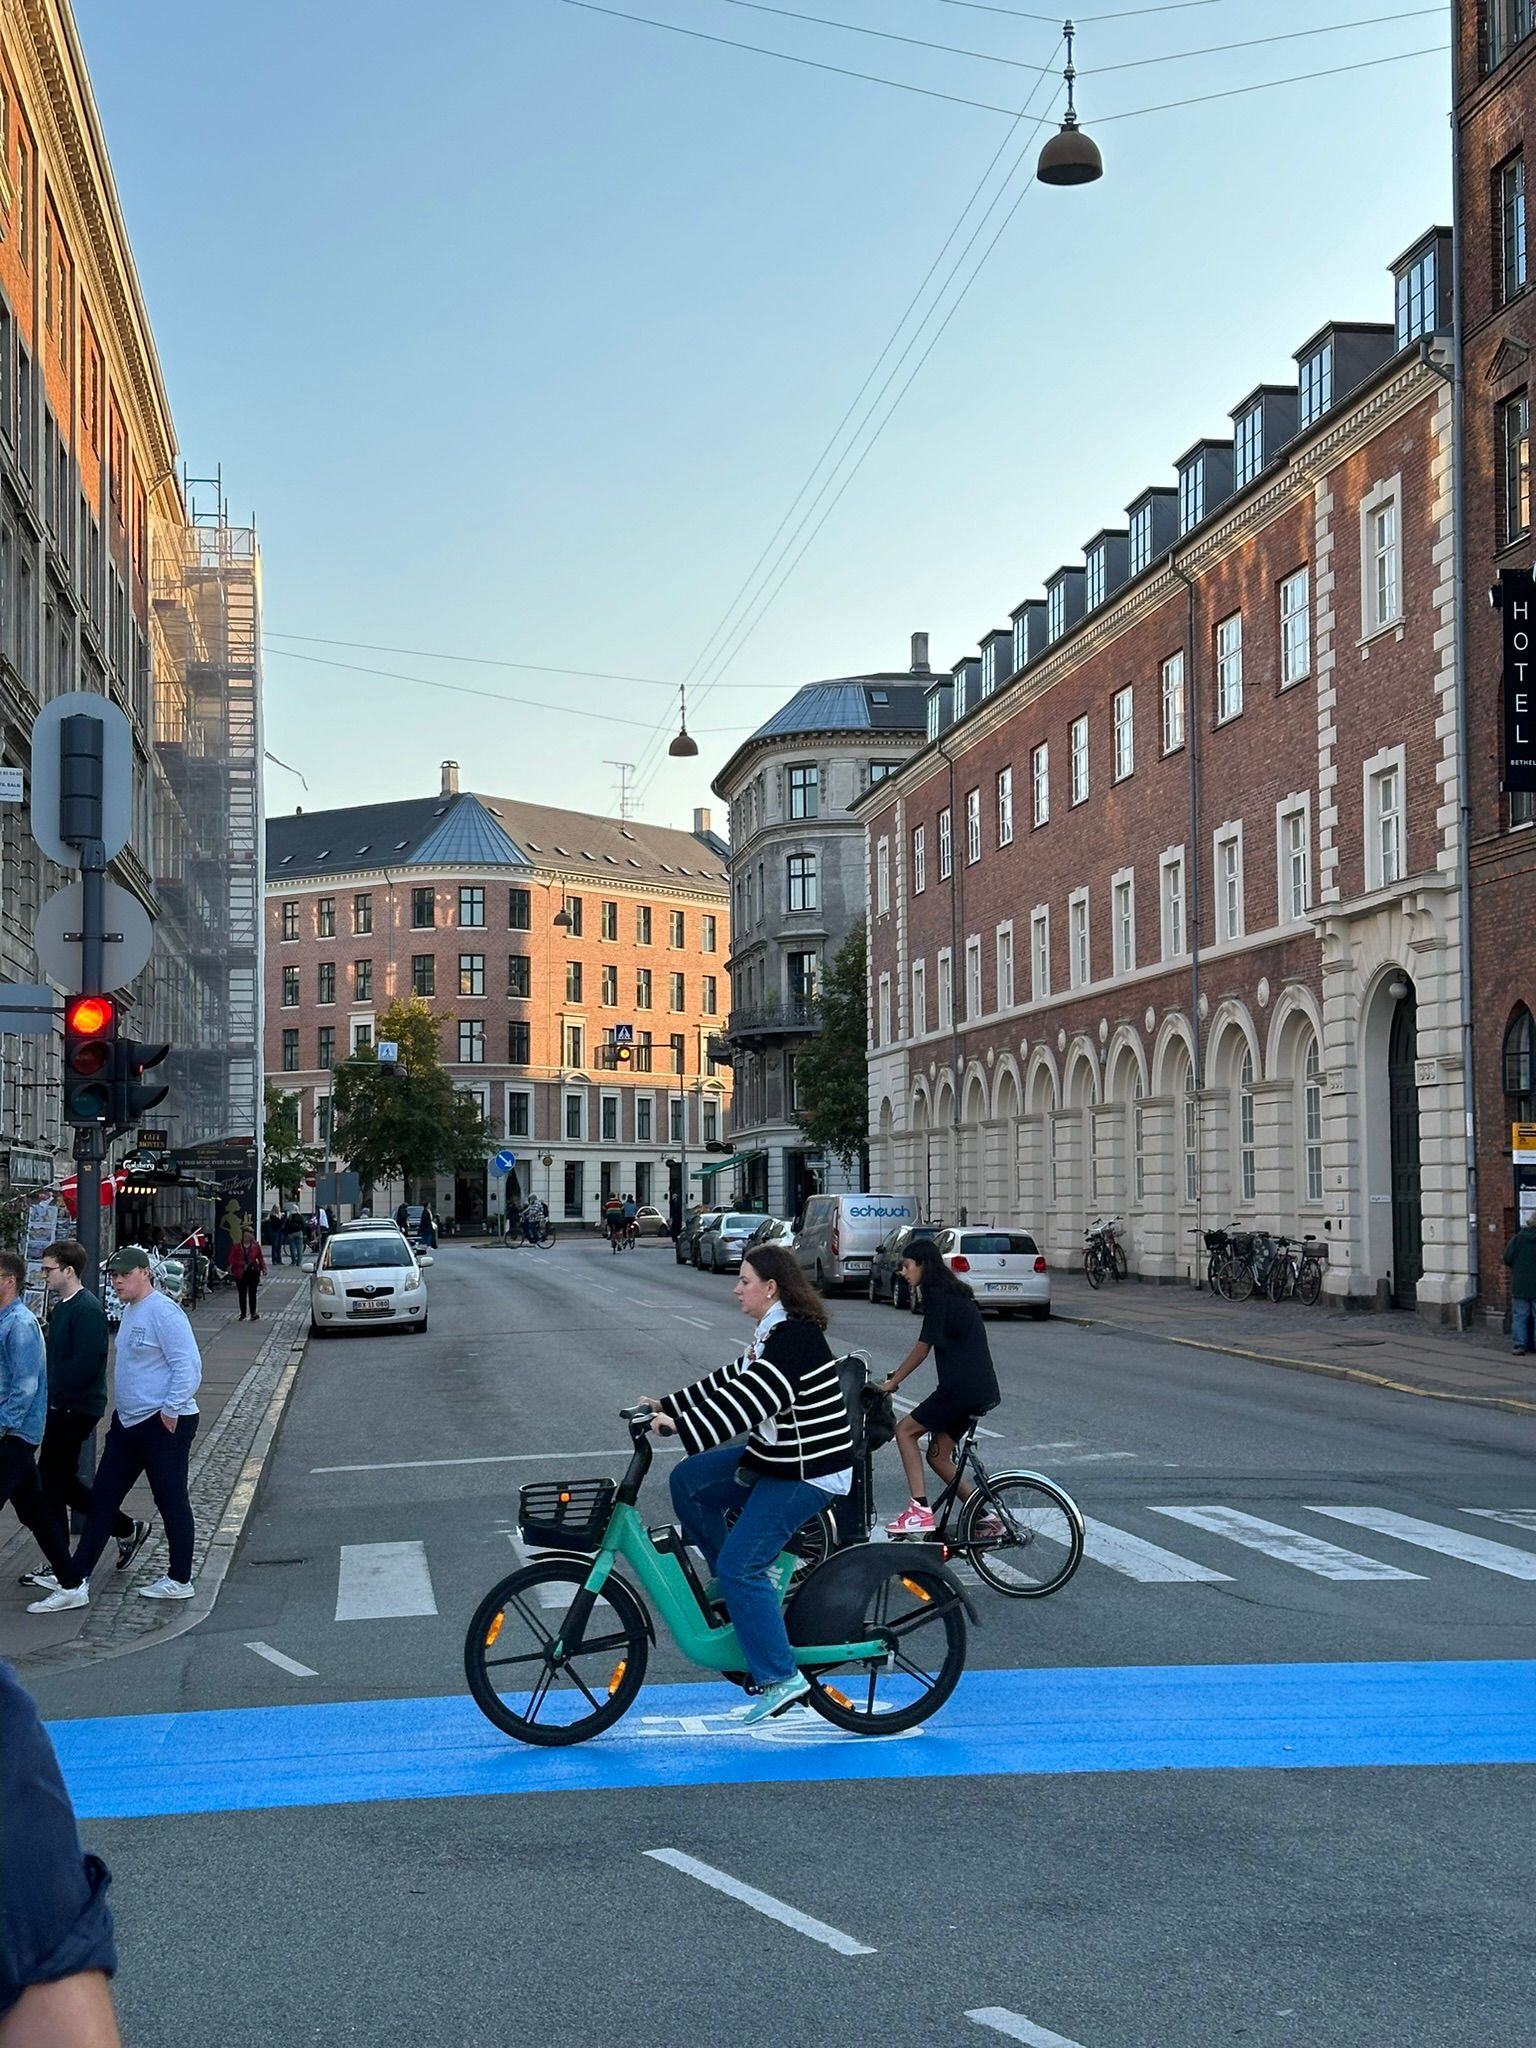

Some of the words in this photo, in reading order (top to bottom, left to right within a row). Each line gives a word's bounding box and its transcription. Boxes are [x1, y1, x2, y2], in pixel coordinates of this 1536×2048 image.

[1514, 601, 1528, 743] HOTEL
[1510, 759, 1536, 767] BETHEL
[123, 1159, 155, 1173] Carlsberg
[850, 1205, 911, 1217] scheuch
